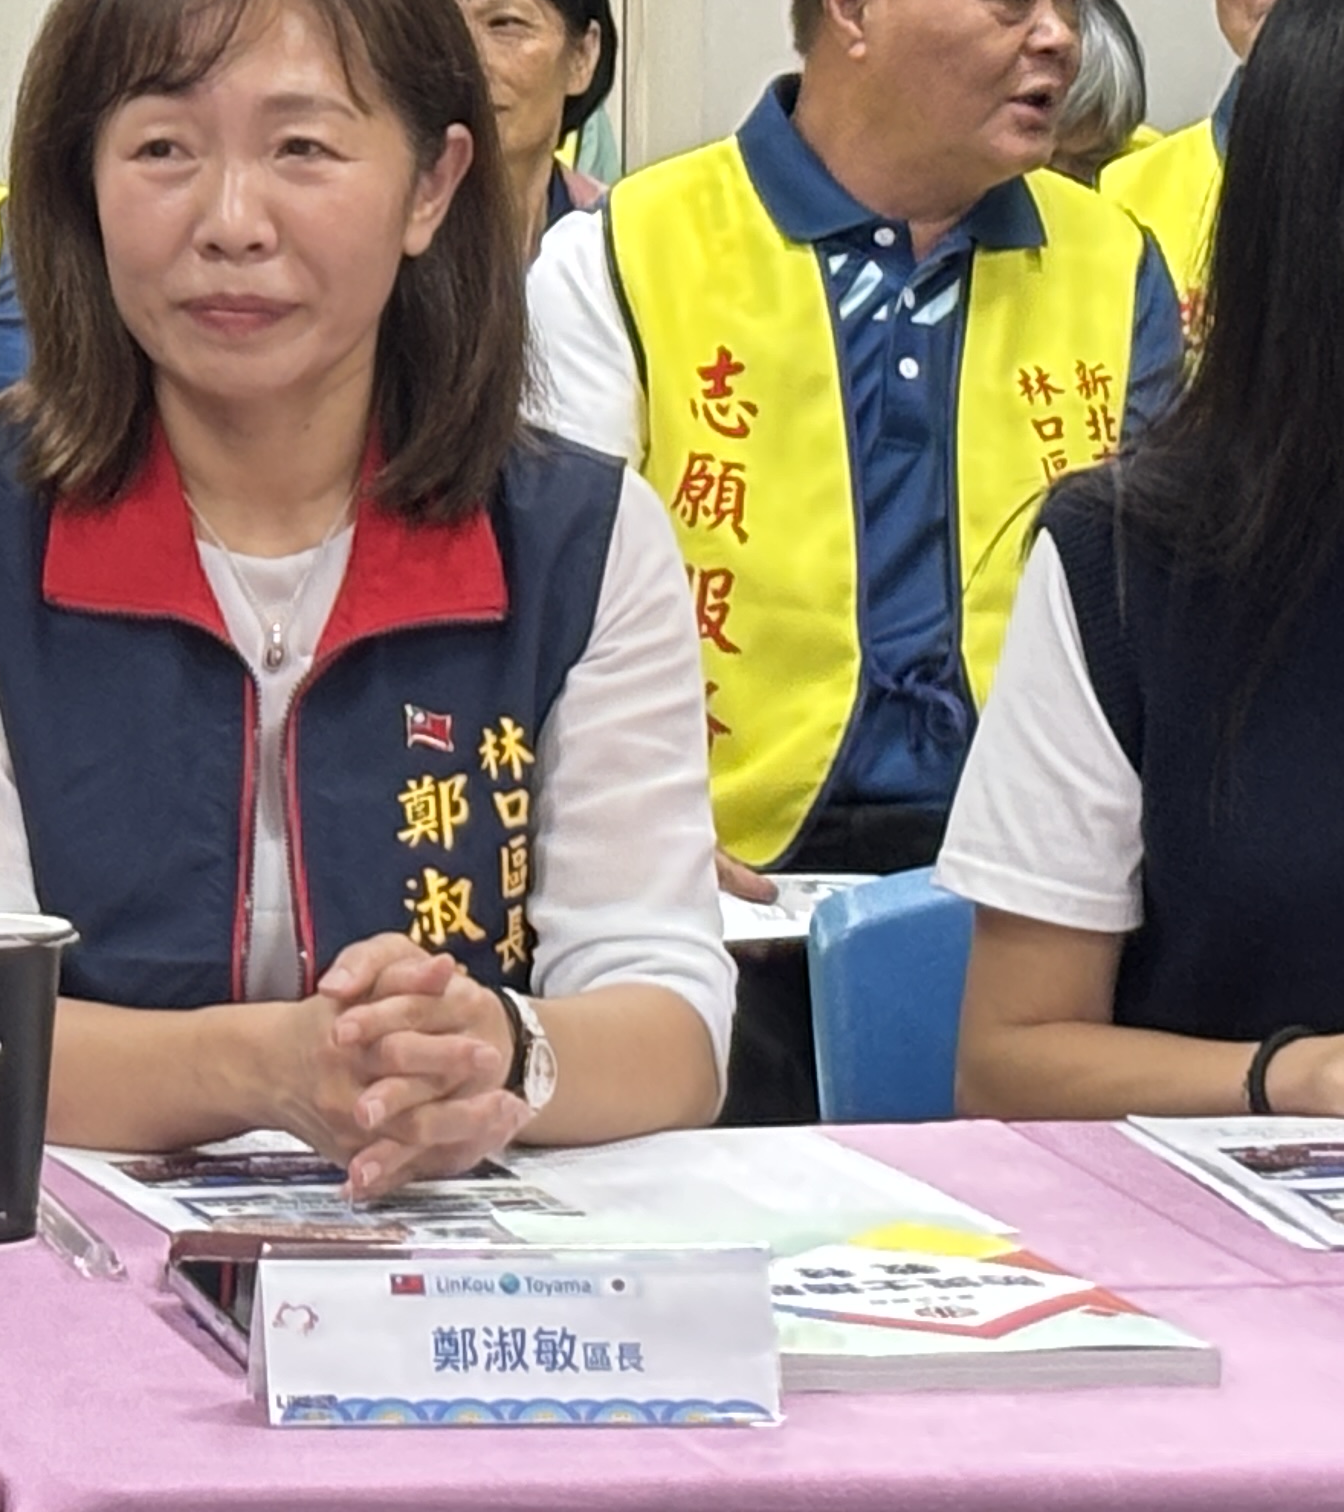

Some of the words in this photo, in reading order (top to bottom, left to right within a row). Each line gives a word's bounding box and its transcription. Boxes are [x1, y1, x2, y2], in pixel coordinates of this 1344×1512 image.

[478, 716, 535, 974] 林口區長
[435, 1275, 496, 1294] LinKou
[524, 1276, 592, 1296] Toyama
[431, 1326, 645, 1373] 鄭淑敏區長
